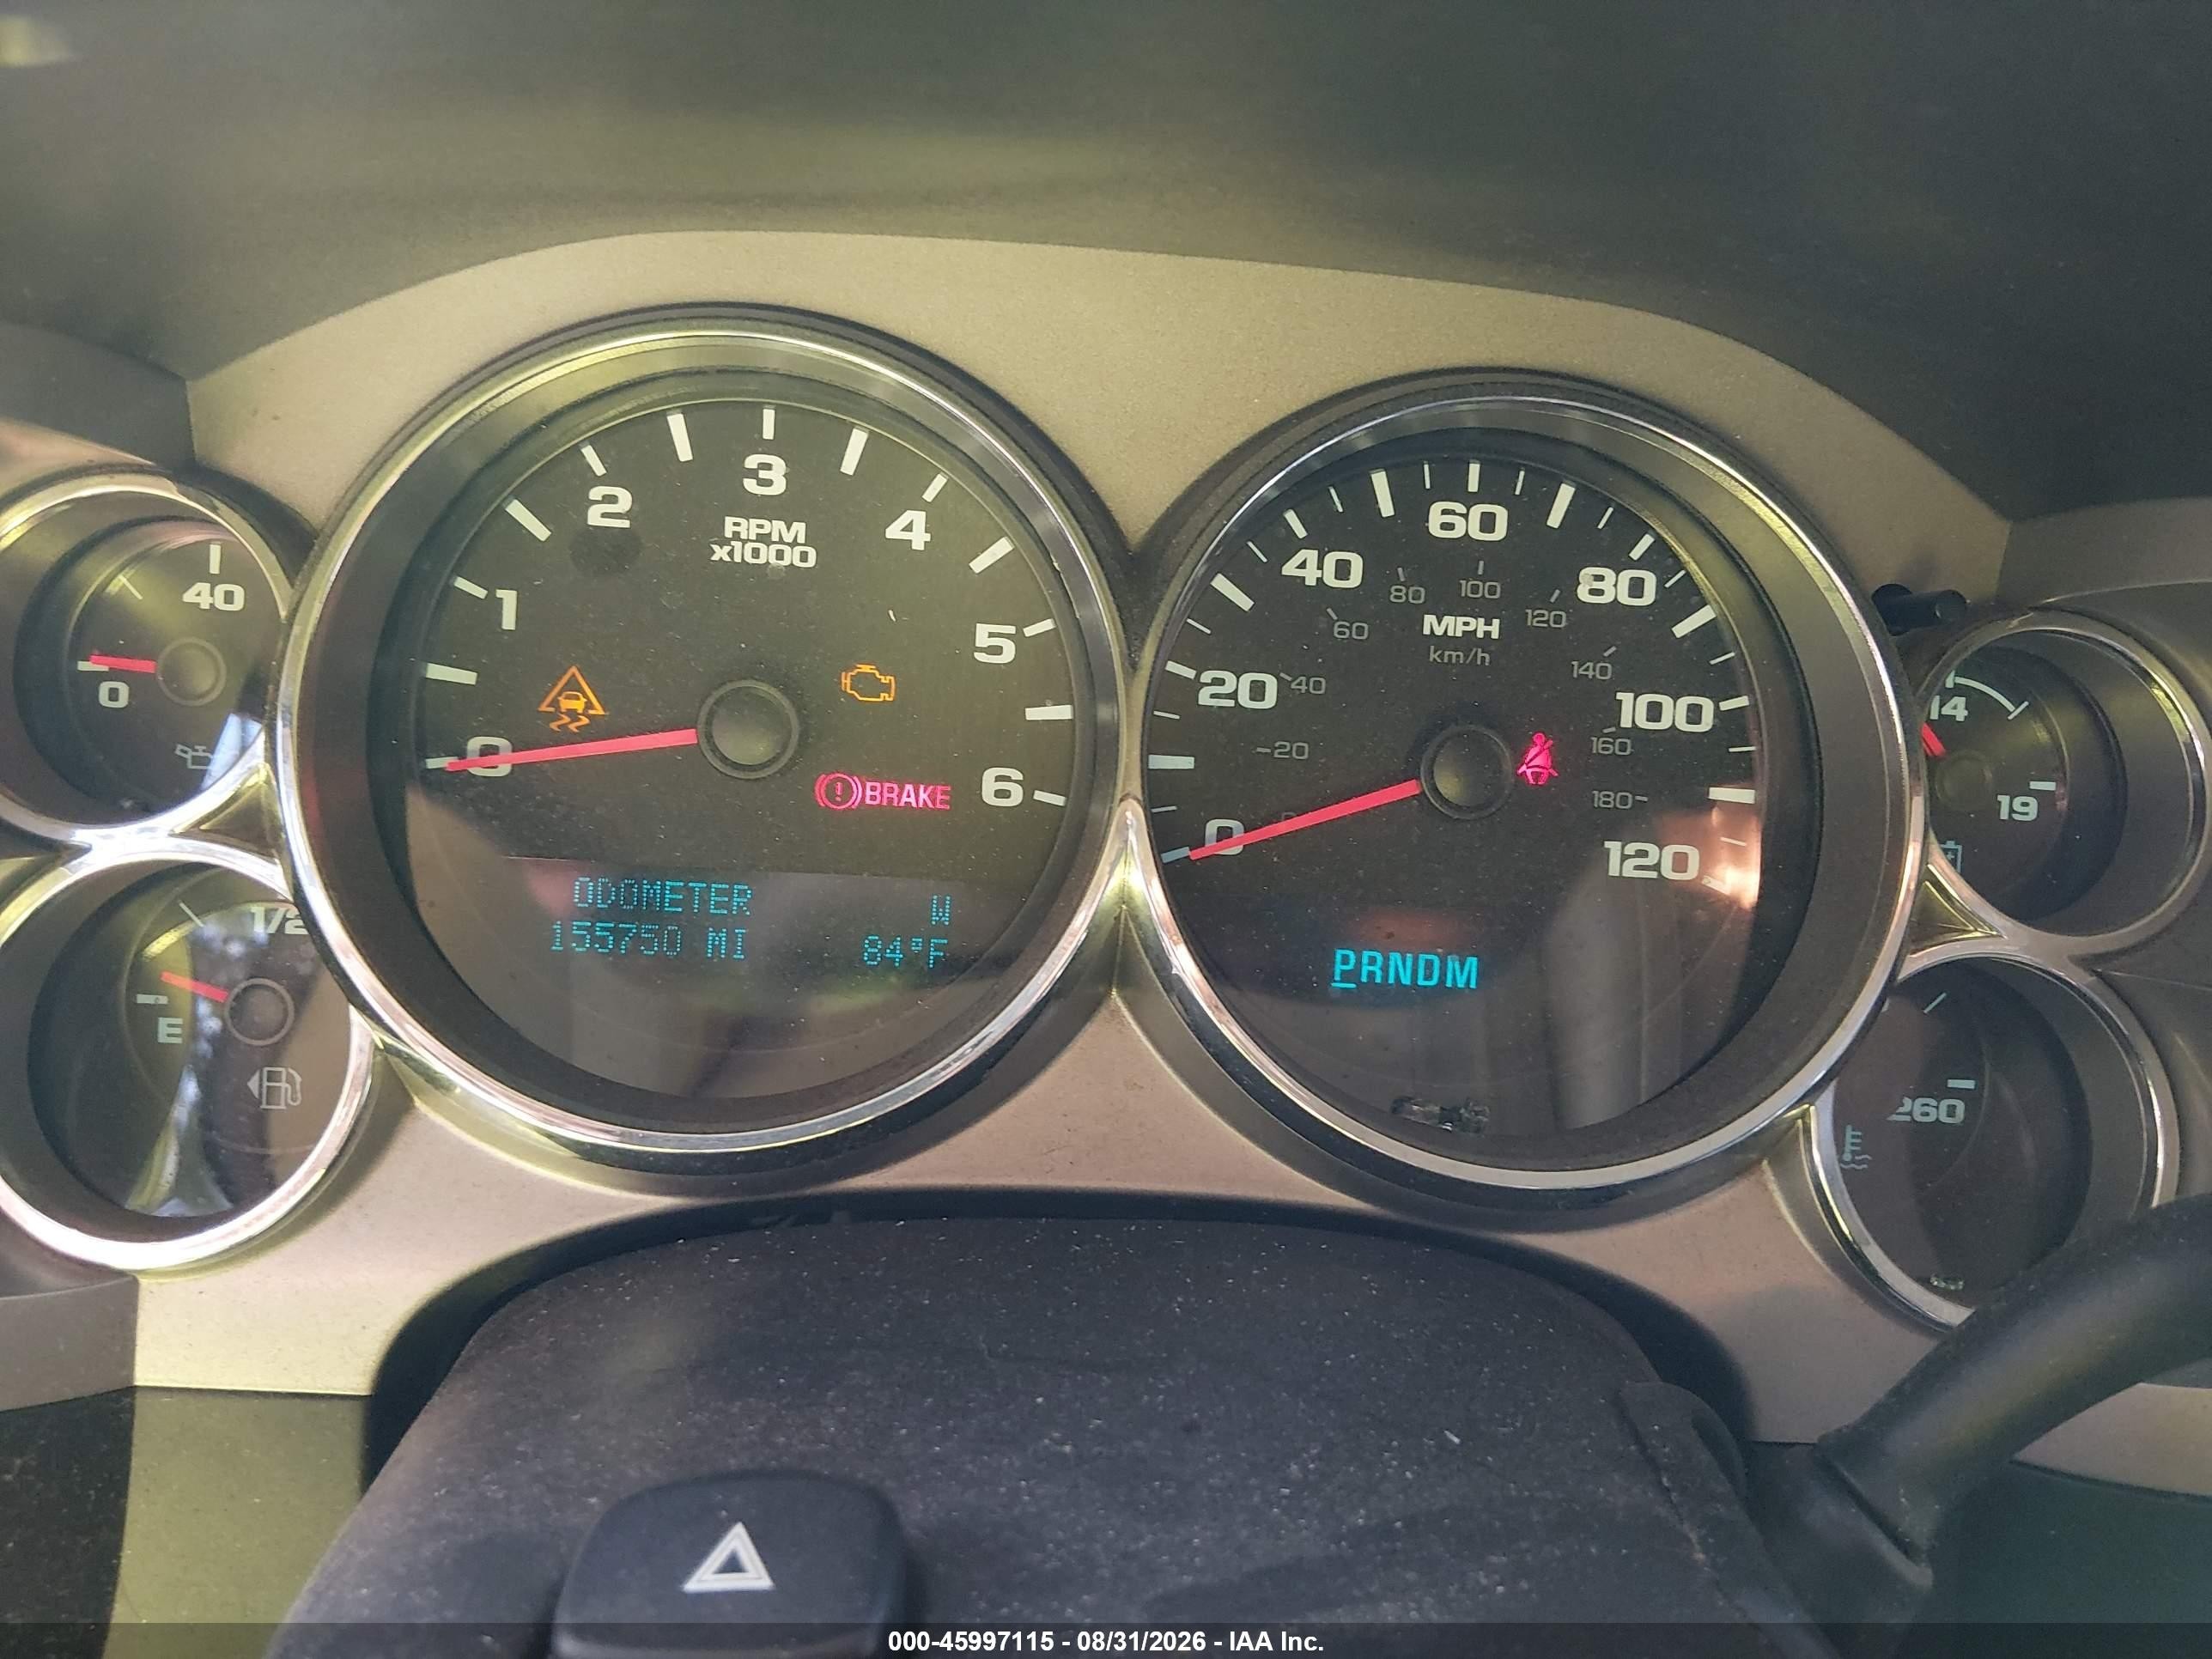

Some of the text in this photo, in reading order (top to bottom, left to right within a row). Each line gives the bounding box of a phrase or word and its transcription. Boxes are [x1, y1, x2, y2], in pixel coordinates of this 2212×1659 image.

[743, 454, 787, 497] 3
[587, 486, 633, 529] 2
[1427, 501, 1508, 542] 60
[723, 516, 807, 544] RPM
[884, 510, 932, 551] 4
[710, 541, 817, 568] x1000
[1281, 549, 1364, 589] 40
[182, 582, 245, 611] 40
[1389, 585, 1425, 605] 80
[1459, 580, 1501, 599] 100
[1577, 567, 1656, 606] 80
[495, 588, 518, 631] 1
[1525, 609, 1567, 629] 120
[1333, 620, 1369, 641] 60
[1422, 614, 1500, 640] MPH
[974, 623, 1017, 664] 5
[1429, 645, 1491, 666] km/h
[1290, 676, 1326, 695] 40
[1571, 660, 1613, 680] 140
[99, 681, 130, 708] 0
[1197, 670, 1278, 709] 20
[1616, 692, 1714, 733] 100
[1929, 695, 1968, 722] 14
[467, 736, 513, 777] 0
[1270, 741, 1310, 760] 20
[1590, 736, 1632, 756] 160
[865, 781, 951, 811] BRAKE
[981, 767, 1024, 808] 6
[1592, 790, 1633, 810] 180
[1996, 794, 2039, 822] 19
[1205, 818, 1244, 855] 0
[1603, 841, 1700, 881] 120
[573, 877, 753, 915] ODOMETER
[931, 894, 951, 926] W
[550, 920, 747, 959] 155750 MI
[863, 935, 949, 969] 84°F
[1333, 948, 1479, 989] PRNDM
[157, 1017, 184, 1044] E
